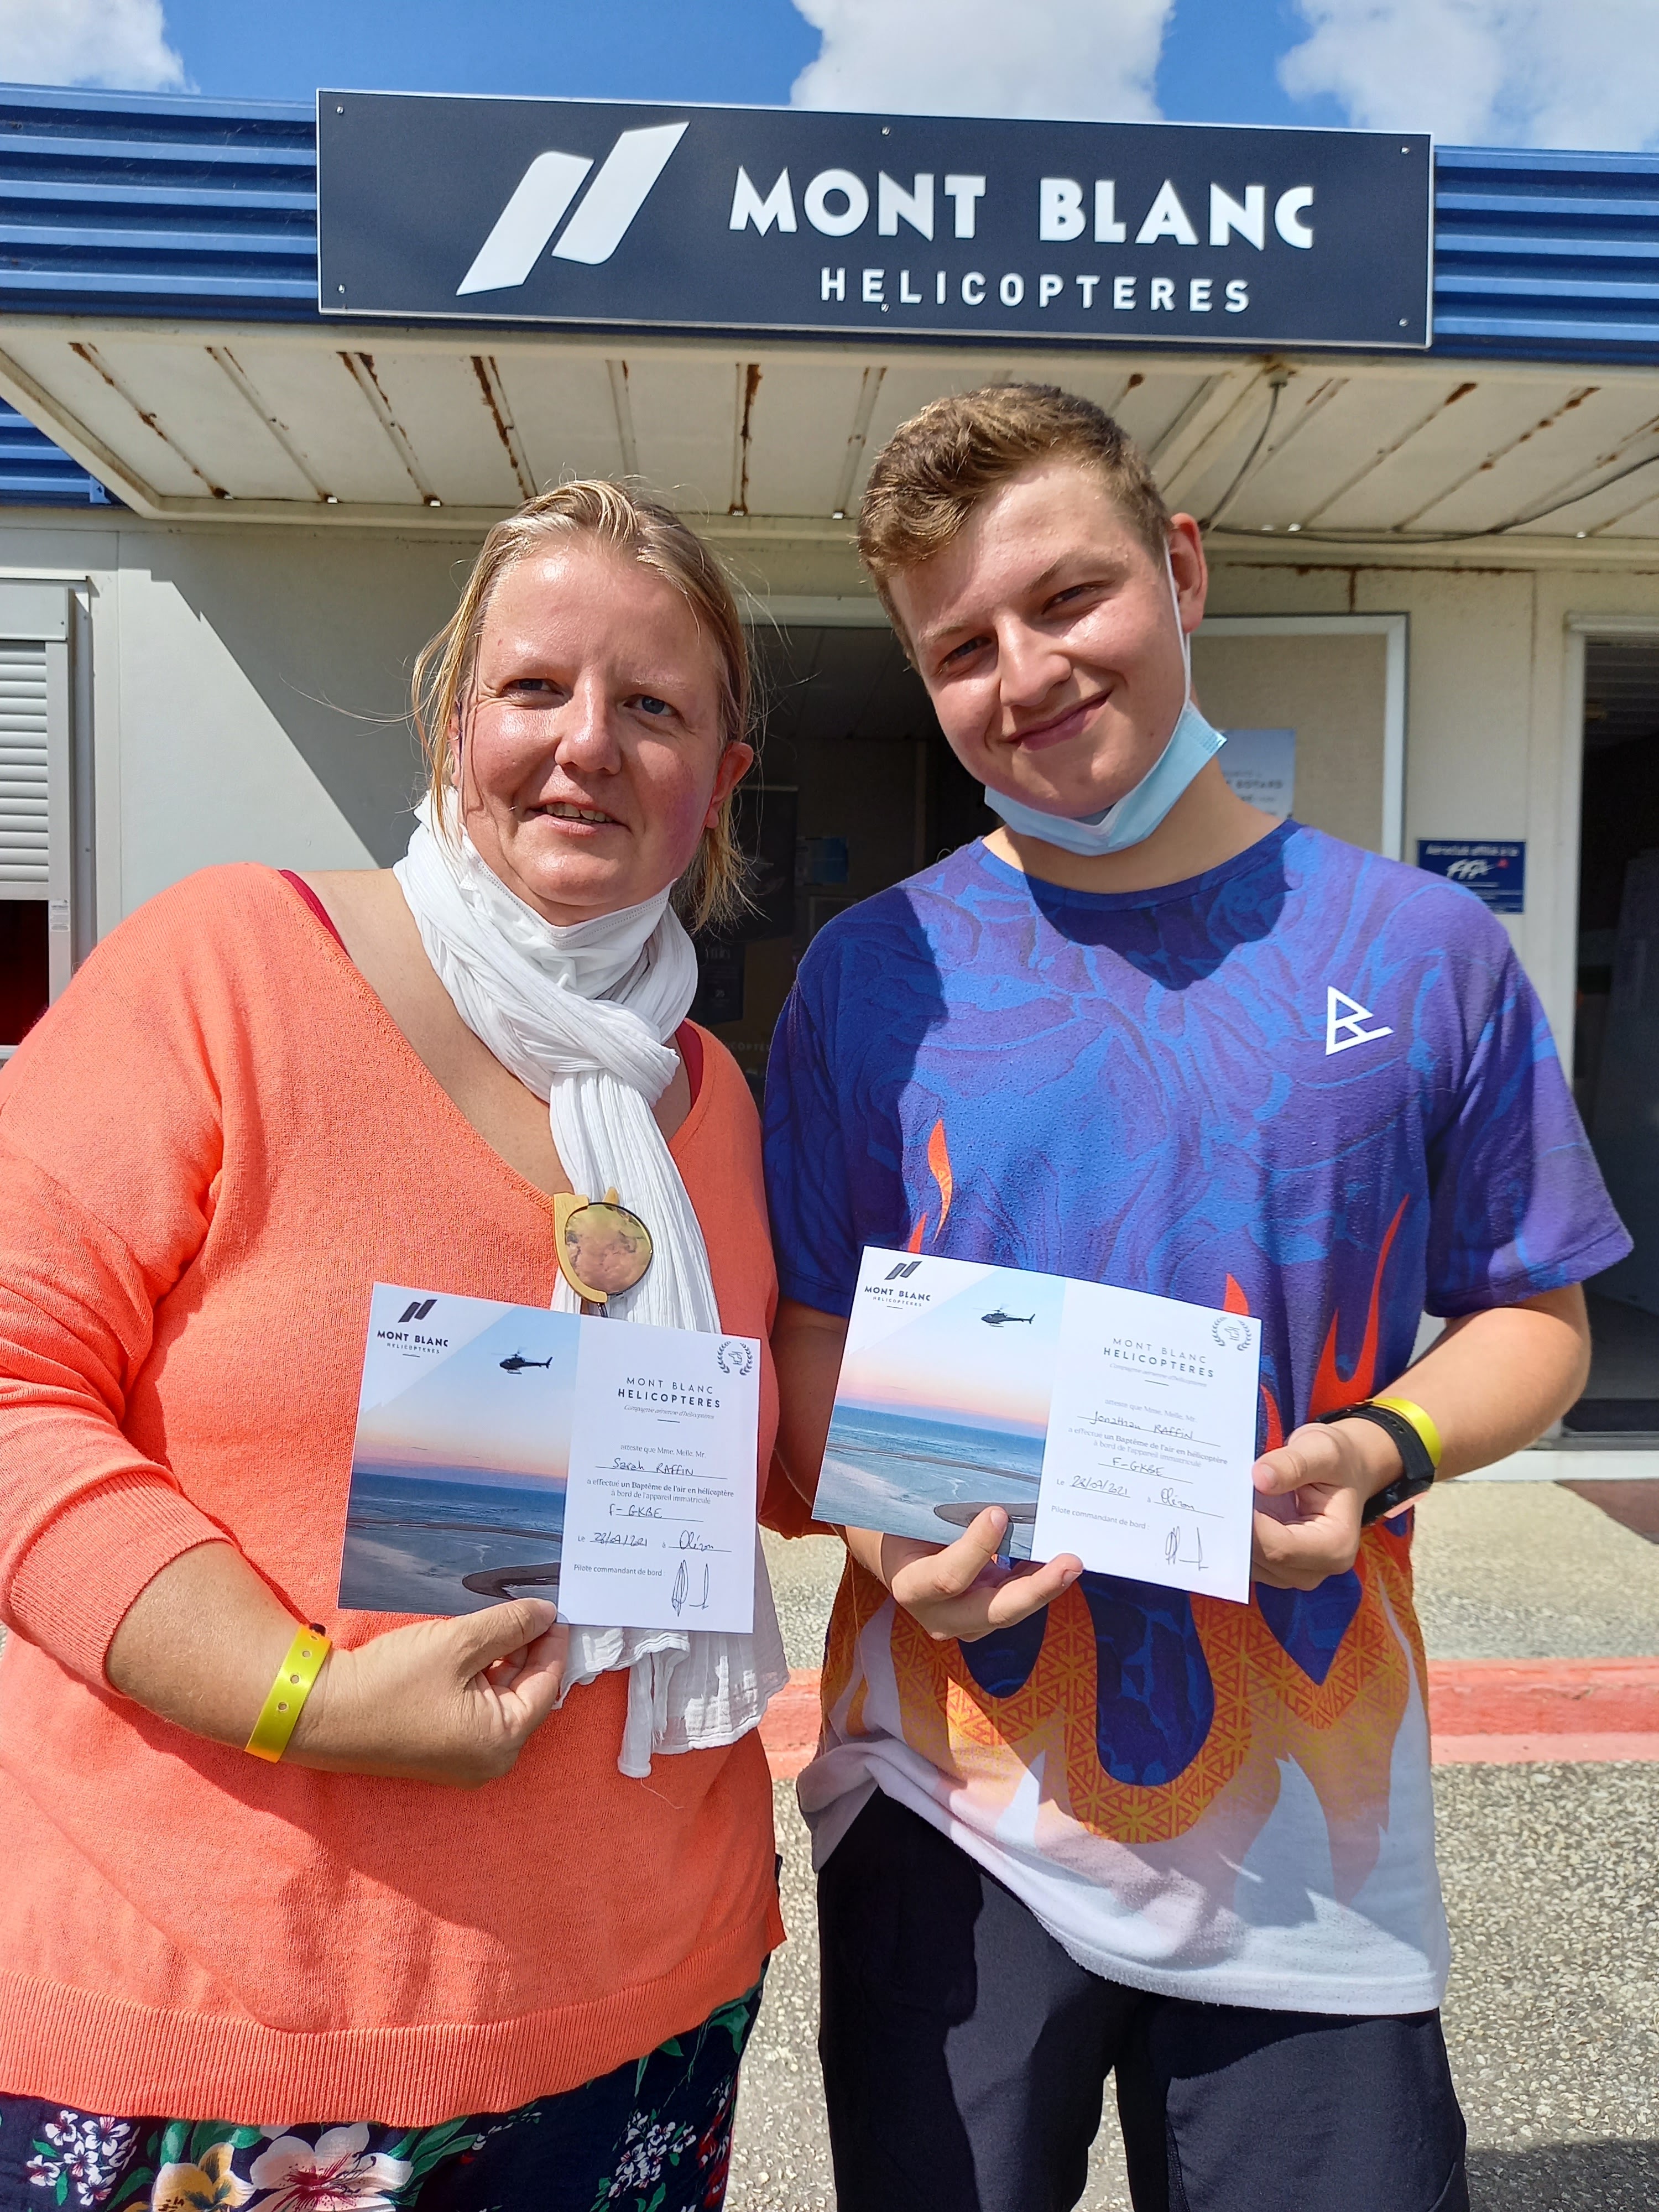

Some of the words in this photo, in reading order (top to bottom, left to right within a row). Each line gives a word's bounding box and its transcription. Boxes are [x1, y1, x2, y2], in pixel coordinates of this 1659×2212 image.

[730, 166, 986, 241] MONT
[1040, 178, 1313, 251] BLANC
[822, 268, 1249, 312] HELICOPTERES
[865, 1285, 894, 1295] MONT
[899, 1290, 931, 1301] BLANC
[377, 1330, 409, 1341] MONT
[415, 1335, 448, 1347] BLANC
[387, 1343, 440, 1354] HELICOPTERES
[1113, 1338, 1152, 1352] MONT
[1161, 1347, 1206, 1364] BLANC
[1104, 1347, 1214, 1378] HELICOPTERES
[627, 1377, 663, 1388] MONT
[672, 1382, 713, 1394] BLANC
[618, 1389, 720, 1408] HELICOPTERES
[1089, 1411, 1141, 1430] Jonathan
[1100, 1441, 1116, 1449] bord
[1116, 1436, 1149, 1447] Baptême
[1187, 1450, 1228, 1464] hélicoptère
[613, 1458, 645, 1471] Sarah
[593, 1478, 619, 1487] effectué
[632, 1481, 662, 1490] Baptême
[697, 1488, 734, 1498] hélicoptère
[643, 1492, 671, 1501] l'appareil
[673, 1495, 711, 1504] immatriculé
[1051, 1505, 1071, 1515] Pilote
[1072, 1510, 1117, 1524] commandant
[593, 1567, 637, 1575] commandant
